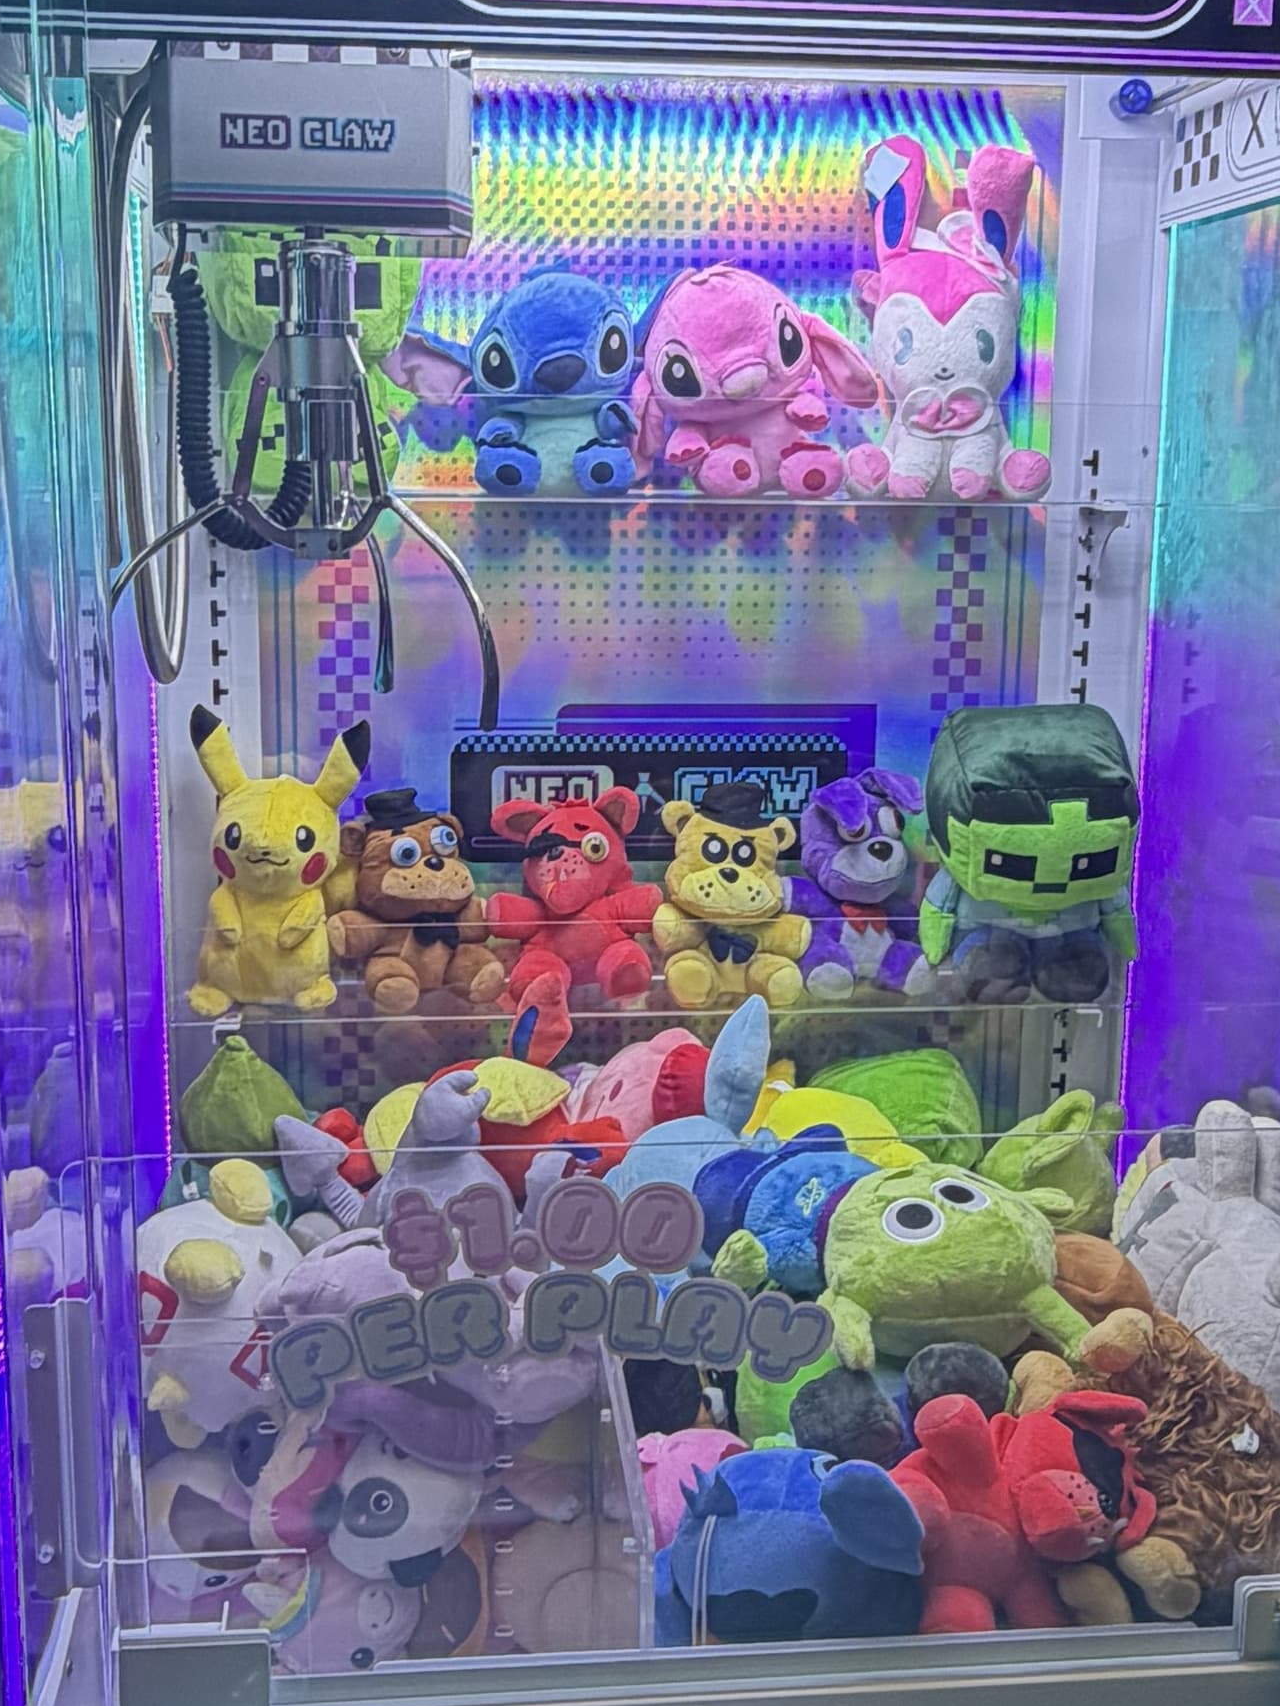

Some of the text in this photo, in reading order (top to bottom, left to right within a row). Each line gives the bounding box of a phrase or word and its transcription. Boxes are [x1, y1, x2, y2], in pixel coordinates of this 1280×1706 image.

[224, 116, 393, 150] NEO CLAW
[509, 772, 810, 811] NEO CW
[386, 1178, 703, 1290] $1.00
[270, 1270, 833, 1411] PER PLAY
